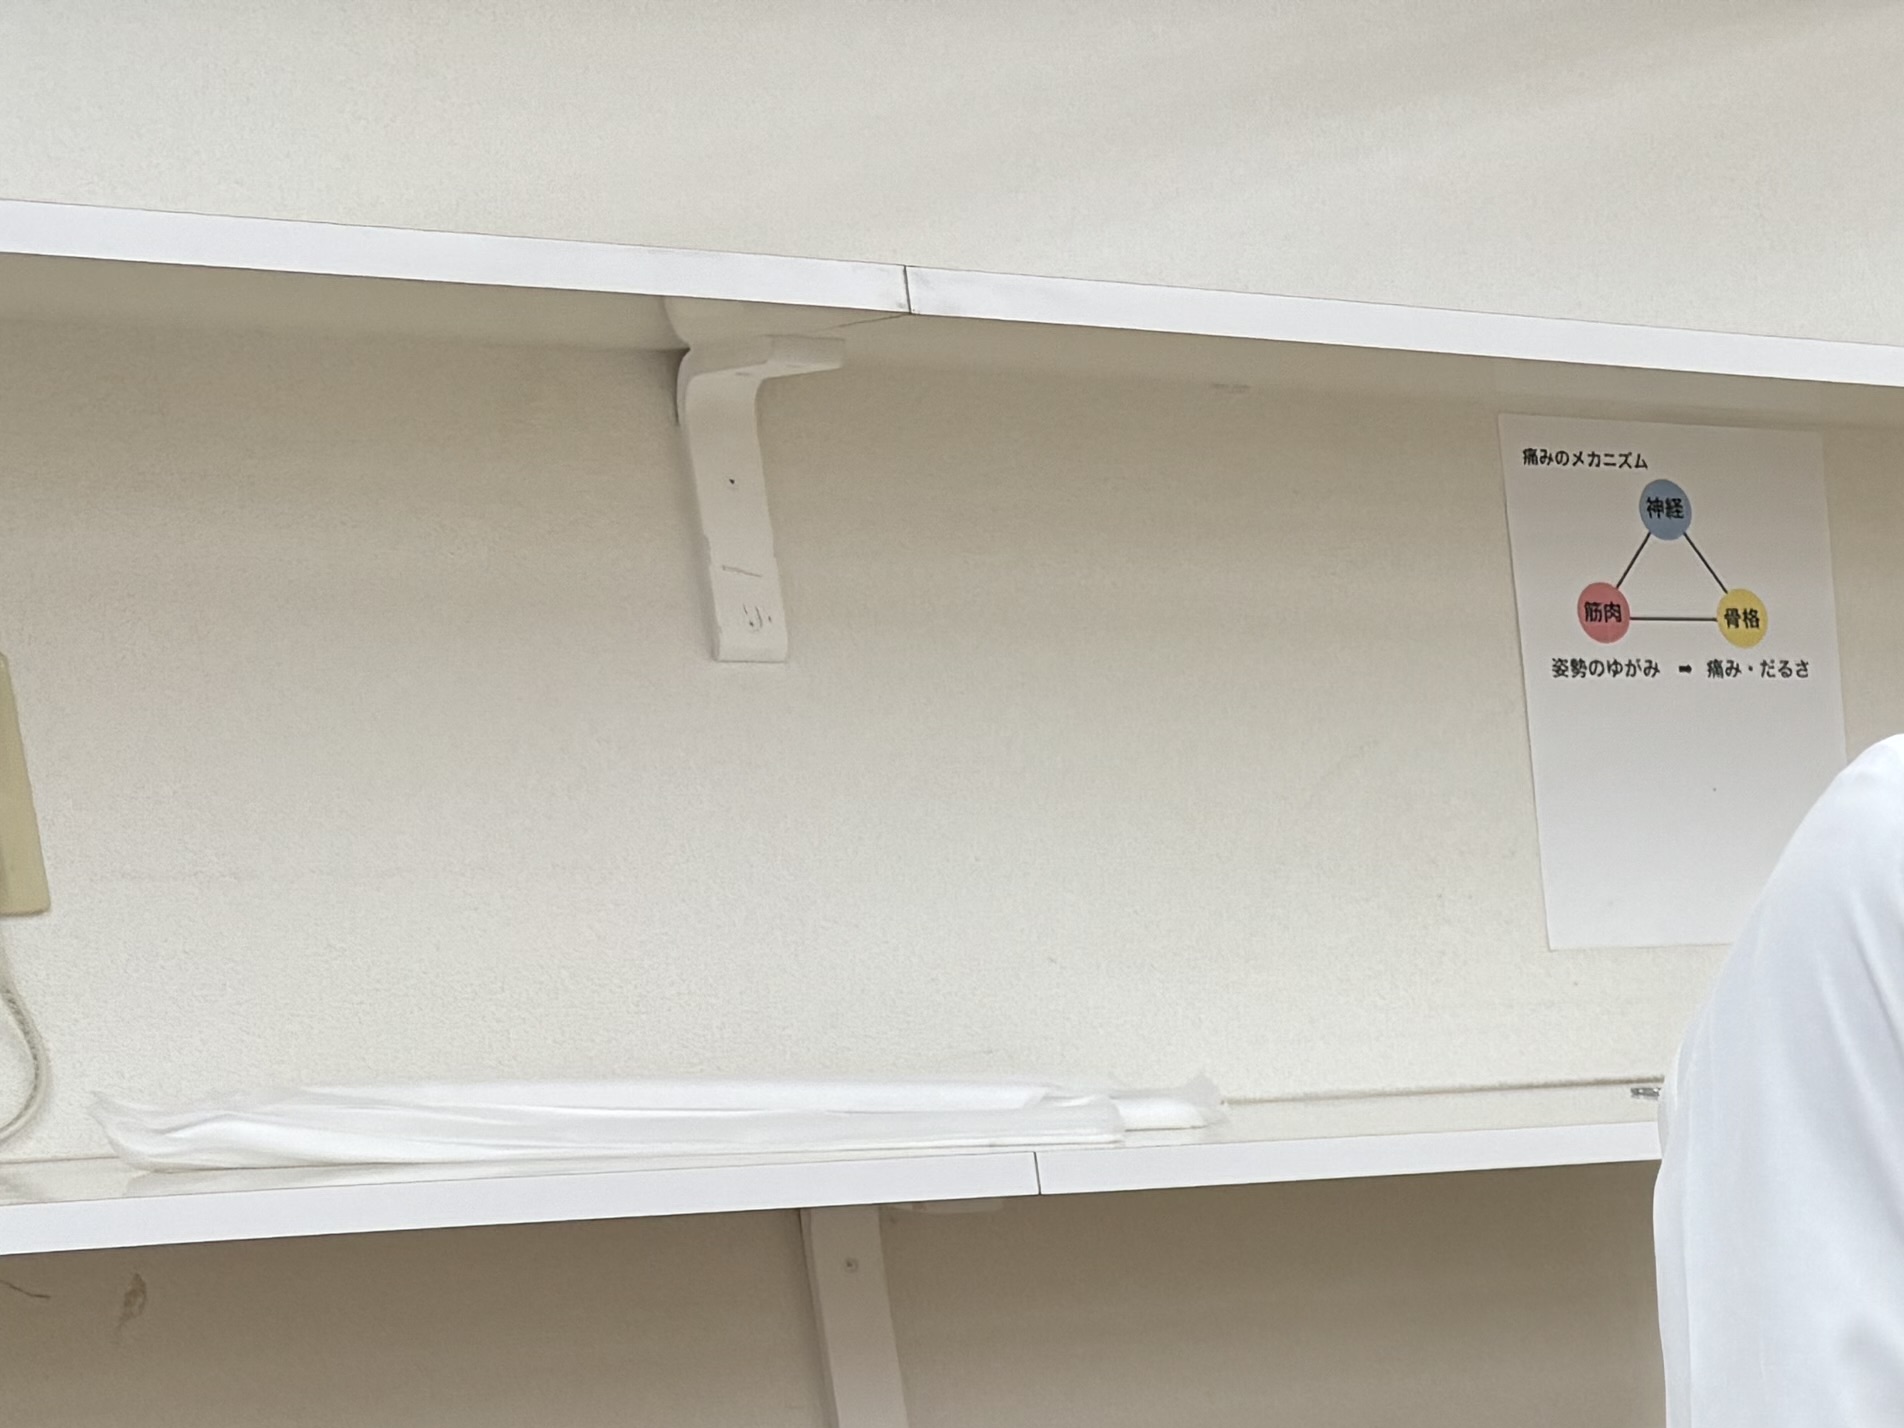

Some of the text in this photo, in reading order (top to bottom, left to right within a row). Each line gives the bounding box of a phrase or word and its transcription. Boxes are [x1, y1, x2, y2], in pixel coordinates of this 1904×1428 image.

[1522, 448, 1649, 470] 痛みのメカニズム
[1646, 497, 1685, 520] 神経
[1583, 602, 1623, 624] 筋肉
[1723, 608, 1760, 630] 骨格
[1551, 657, 1810, 679] 姿勢のゆがみ 痛み・だるさ
